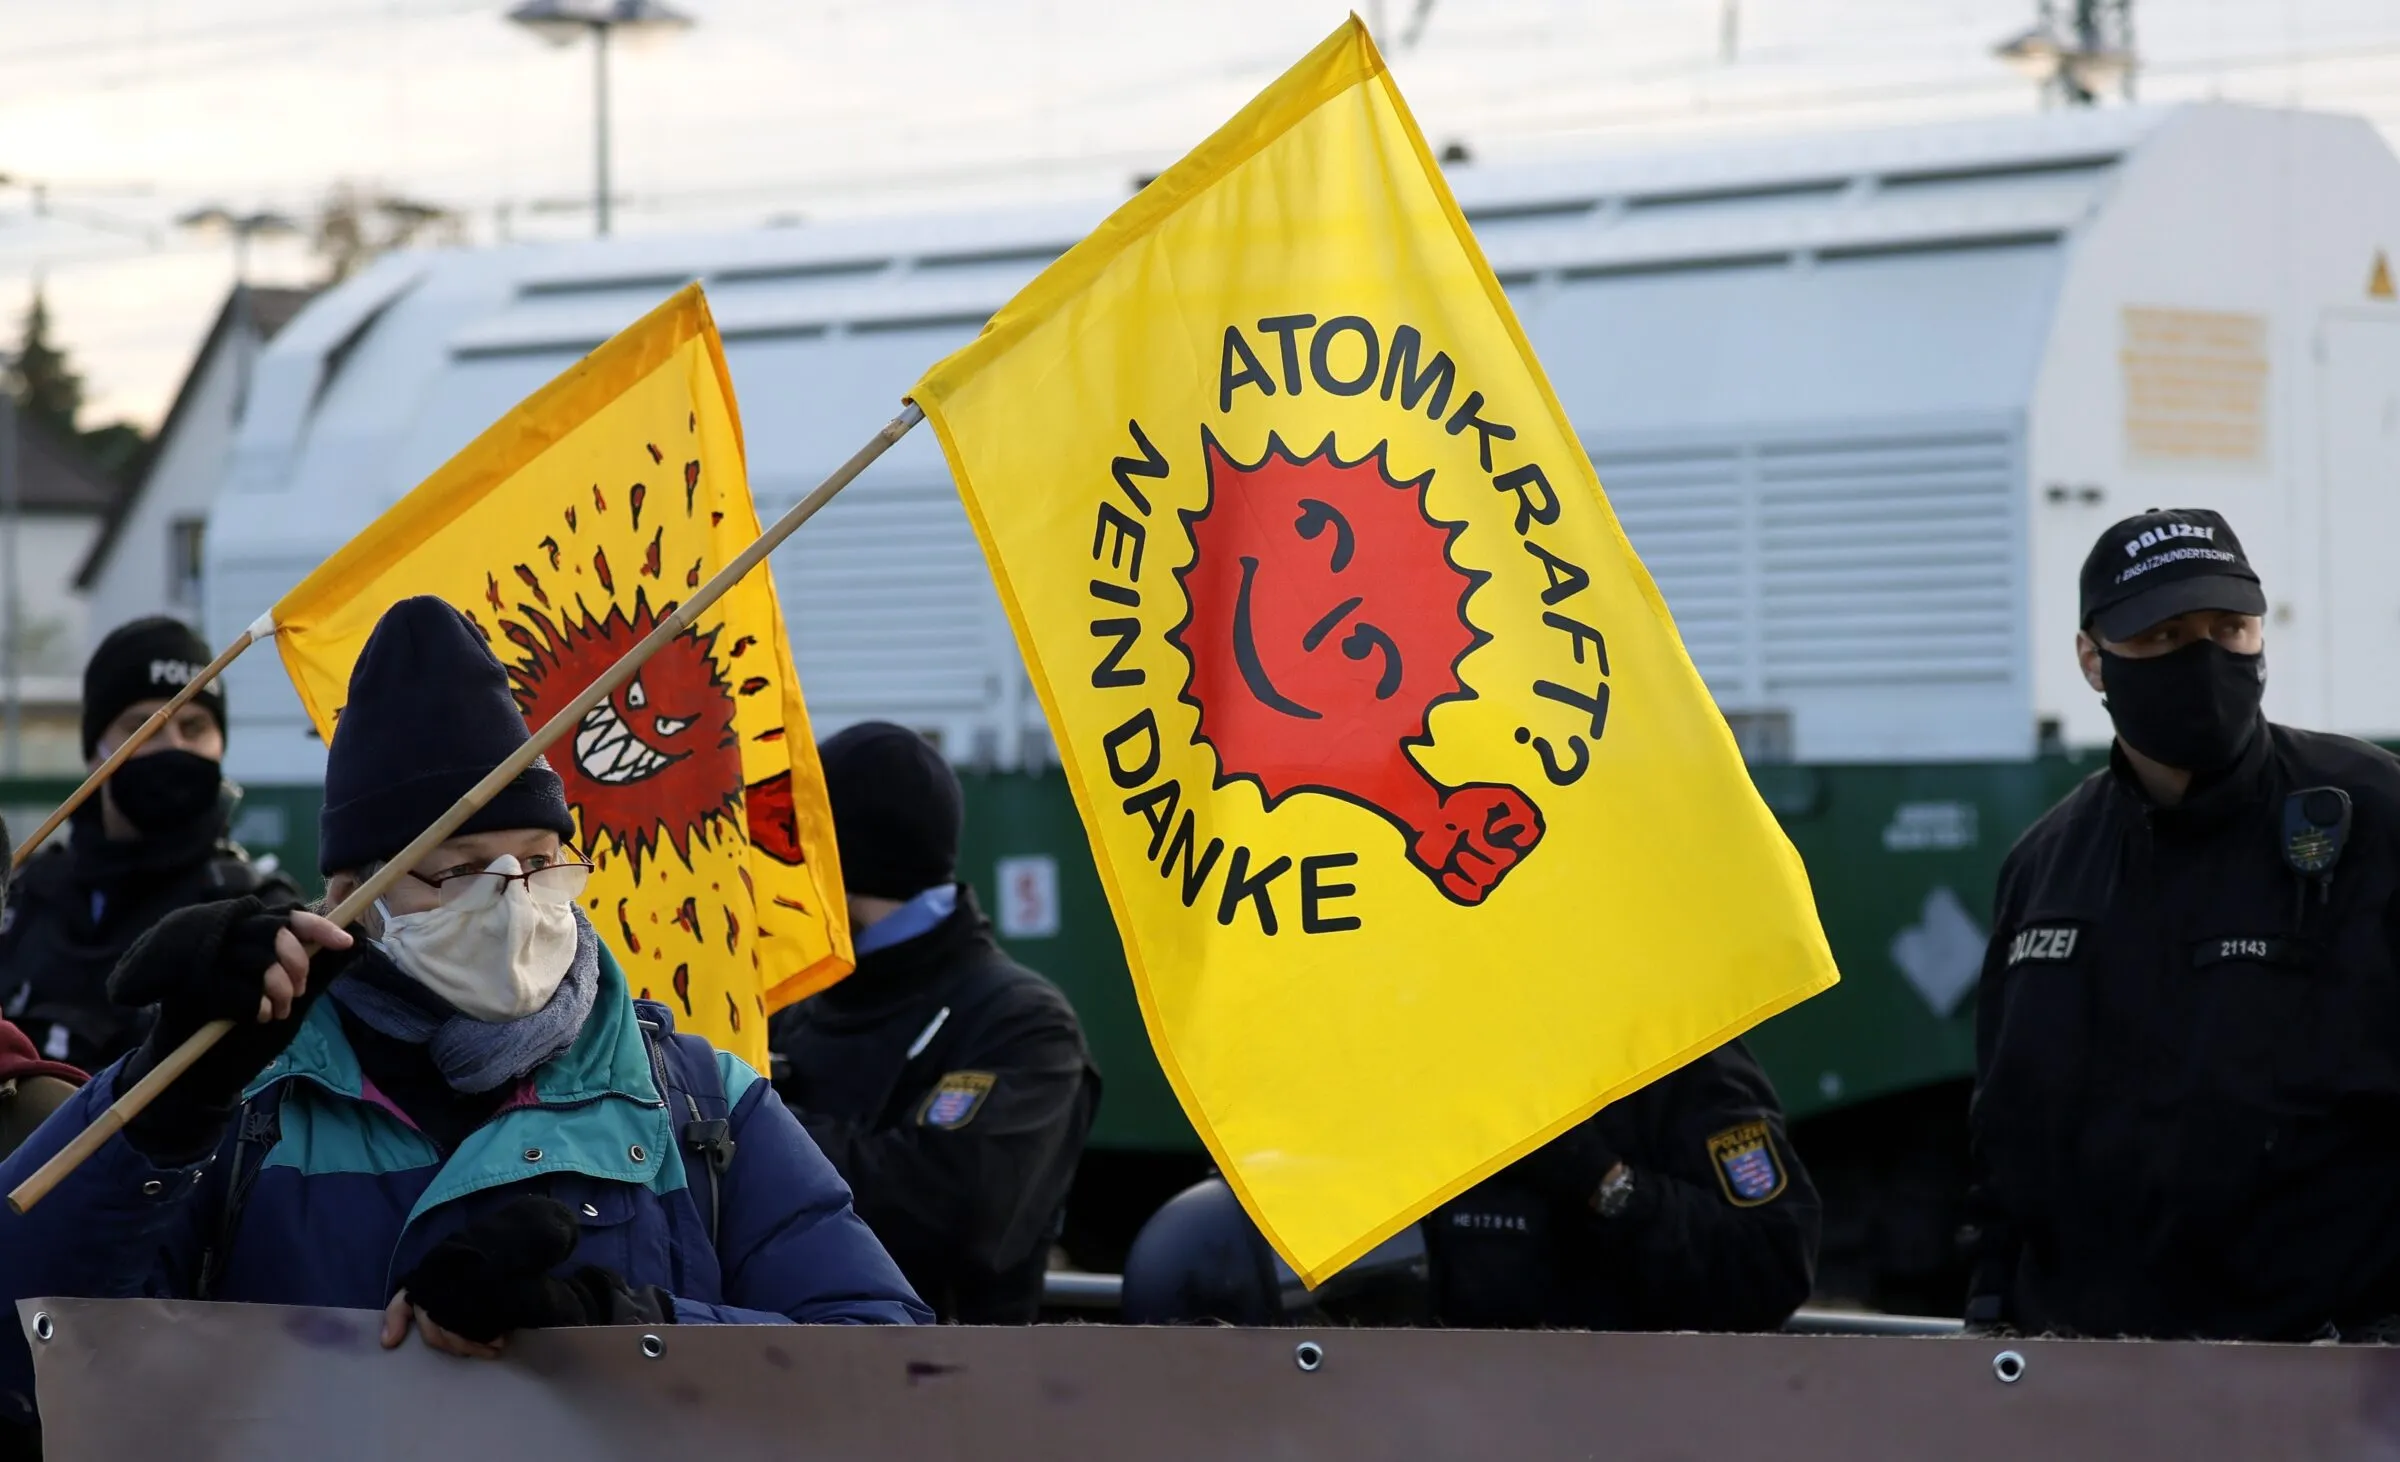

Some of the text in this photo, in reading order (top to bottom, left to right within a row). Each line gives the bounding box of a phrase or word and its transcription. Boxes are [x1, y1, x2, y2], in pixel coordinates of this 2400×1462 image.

[1220, 313, 1611, 788] ATOMKRAFT?
[2124, 522, 2215, 558] POLIZEI
[1090, 418, 1363, 937] NEIN DANKE
[2008, 928, 2078, 966] OLIZEI
[2220, 939, 2267, 957] 21143
